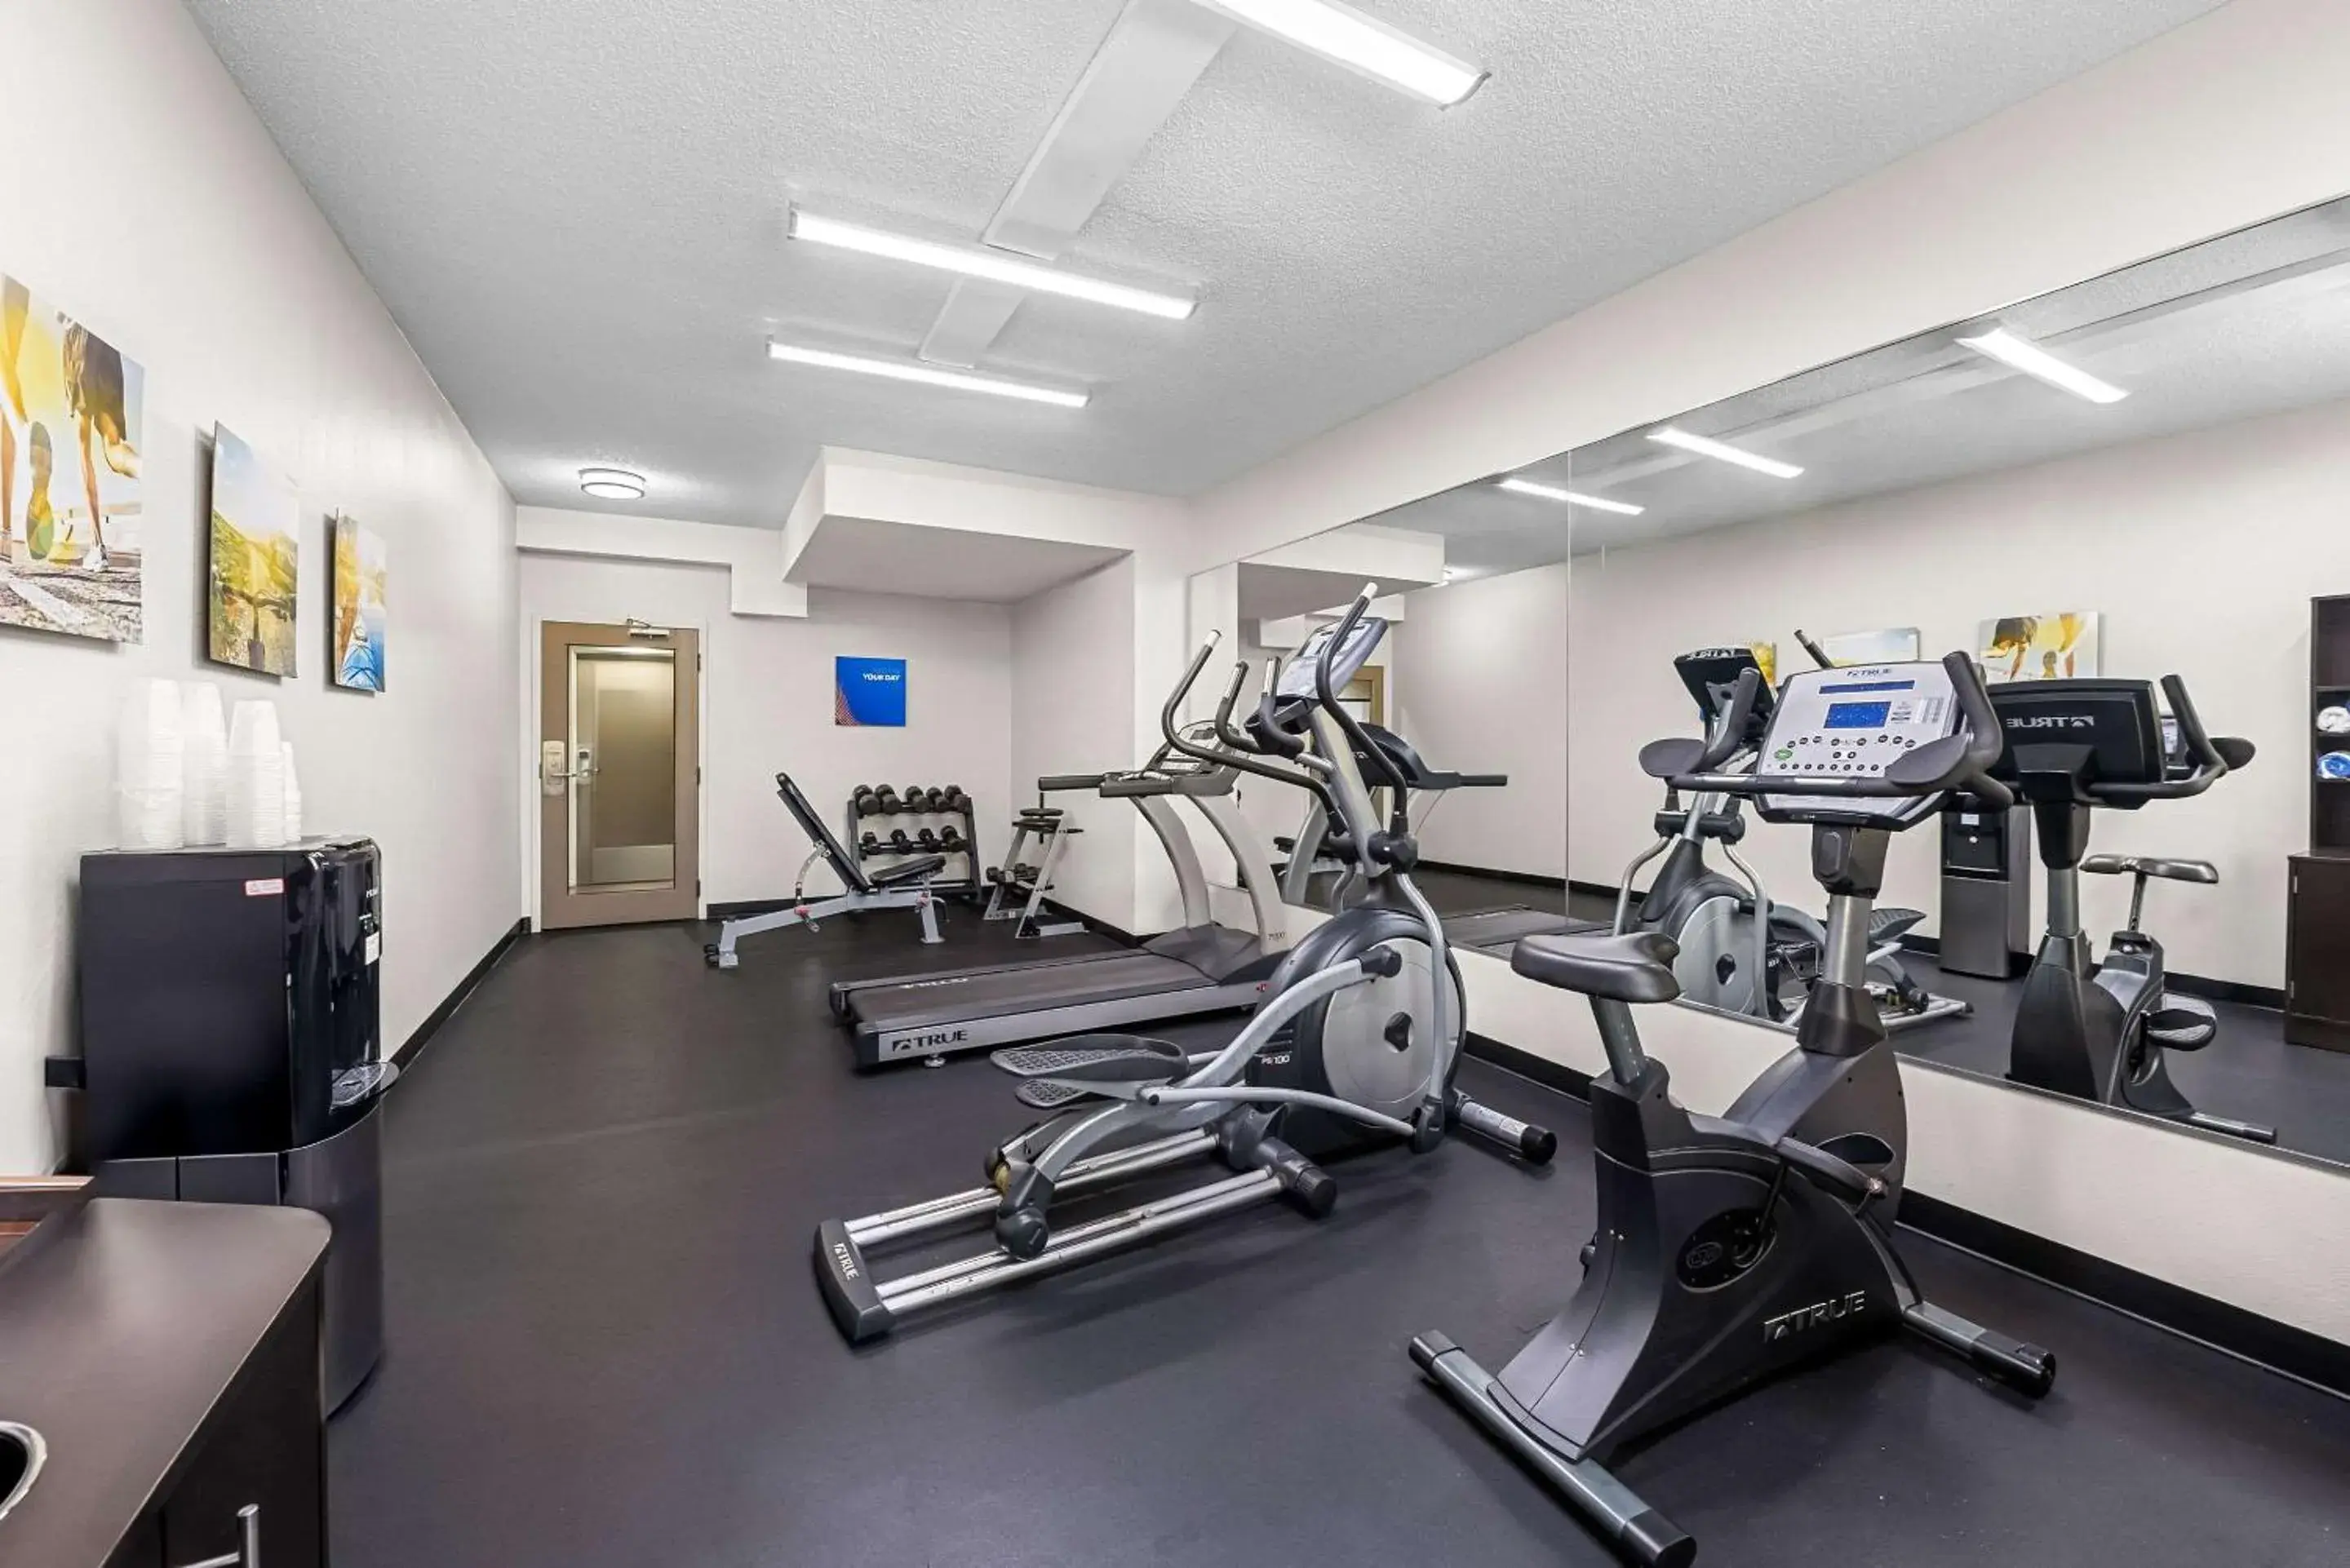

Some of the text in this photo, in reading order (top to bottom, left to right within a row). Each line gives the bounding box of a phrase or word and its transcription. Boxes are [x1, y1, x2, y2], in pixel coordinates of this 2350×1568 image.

[862, 673, 884, 681] YOUR
[913, 1030, 969, 1048] TRUE
[1789, 1289, 1865, 1331] TRUE
